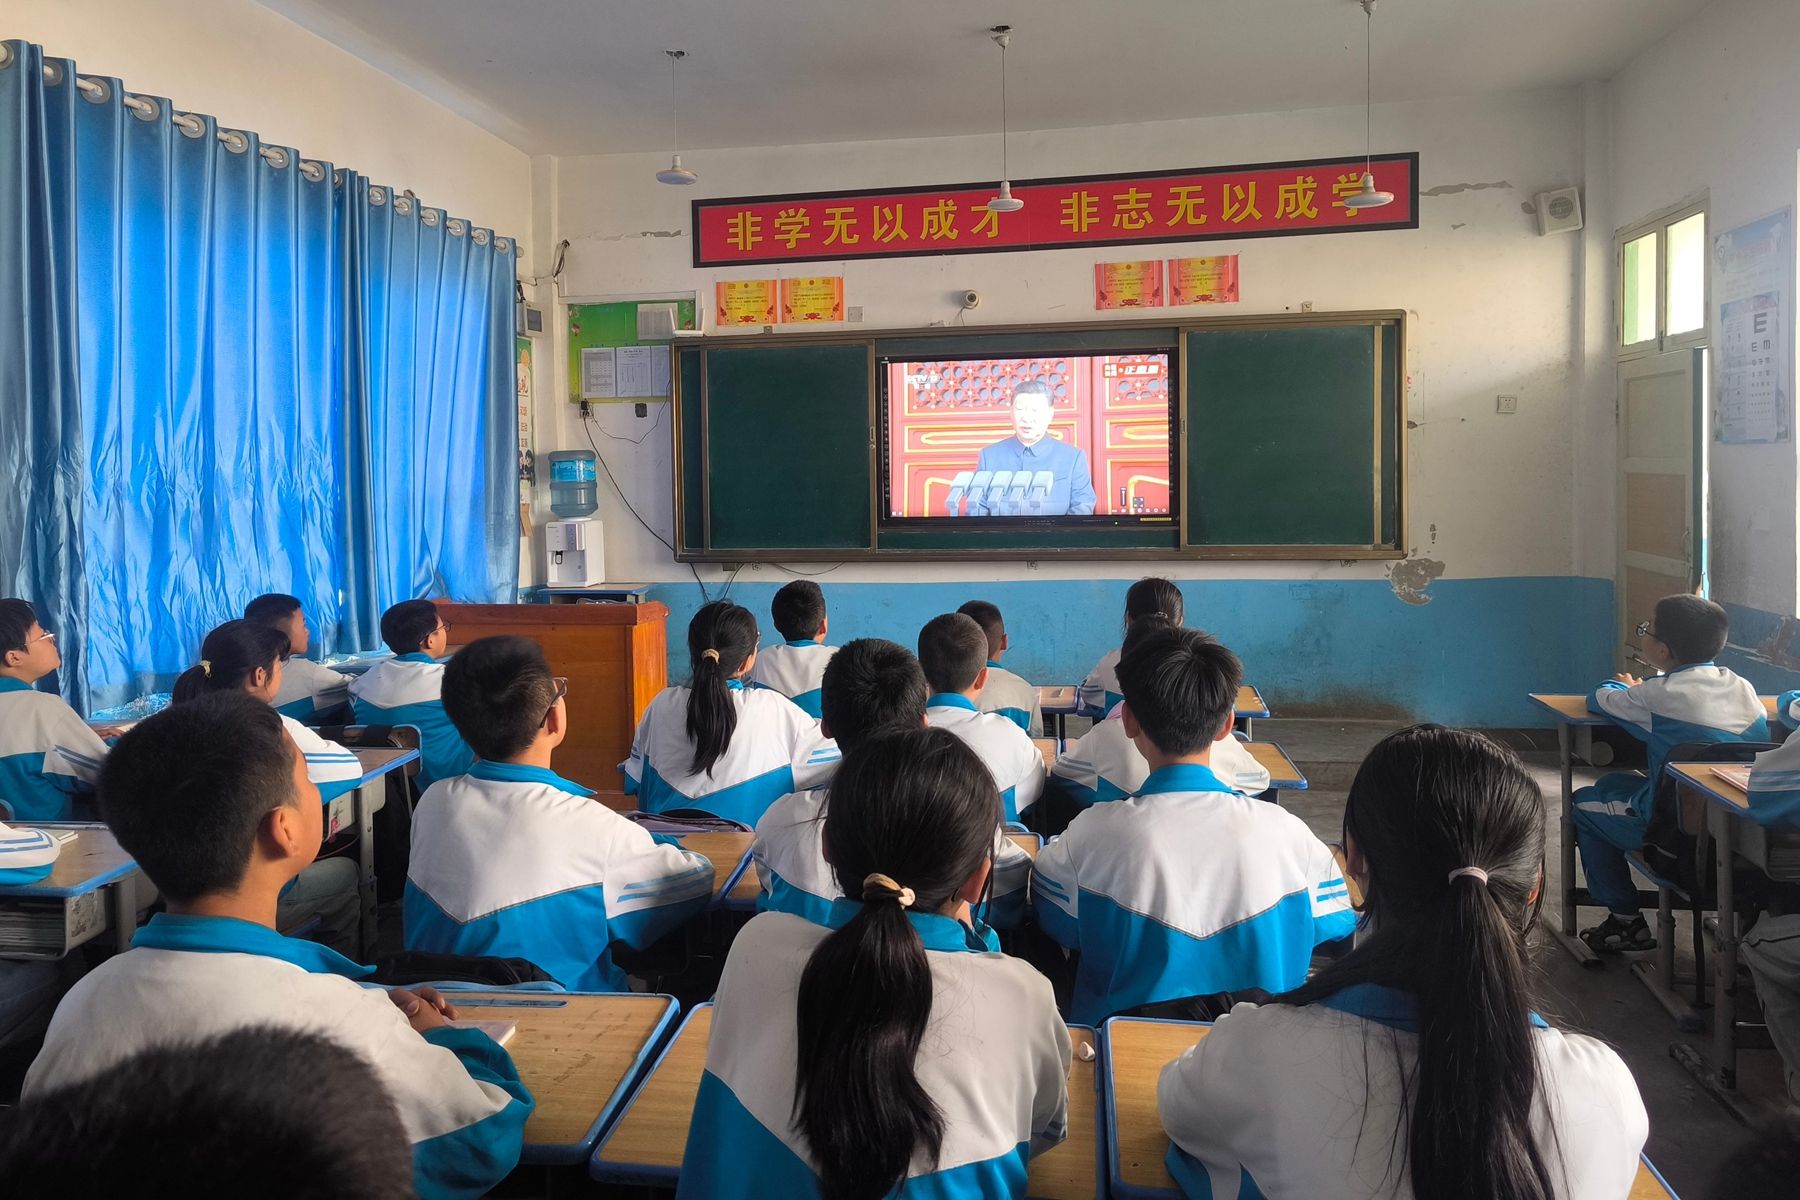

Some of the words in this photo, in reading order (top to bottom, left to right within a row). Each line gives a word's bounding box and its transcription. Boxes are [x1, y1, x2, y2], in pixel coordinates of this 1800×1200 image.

[726, 197, 999, 252] 非学无以成才
